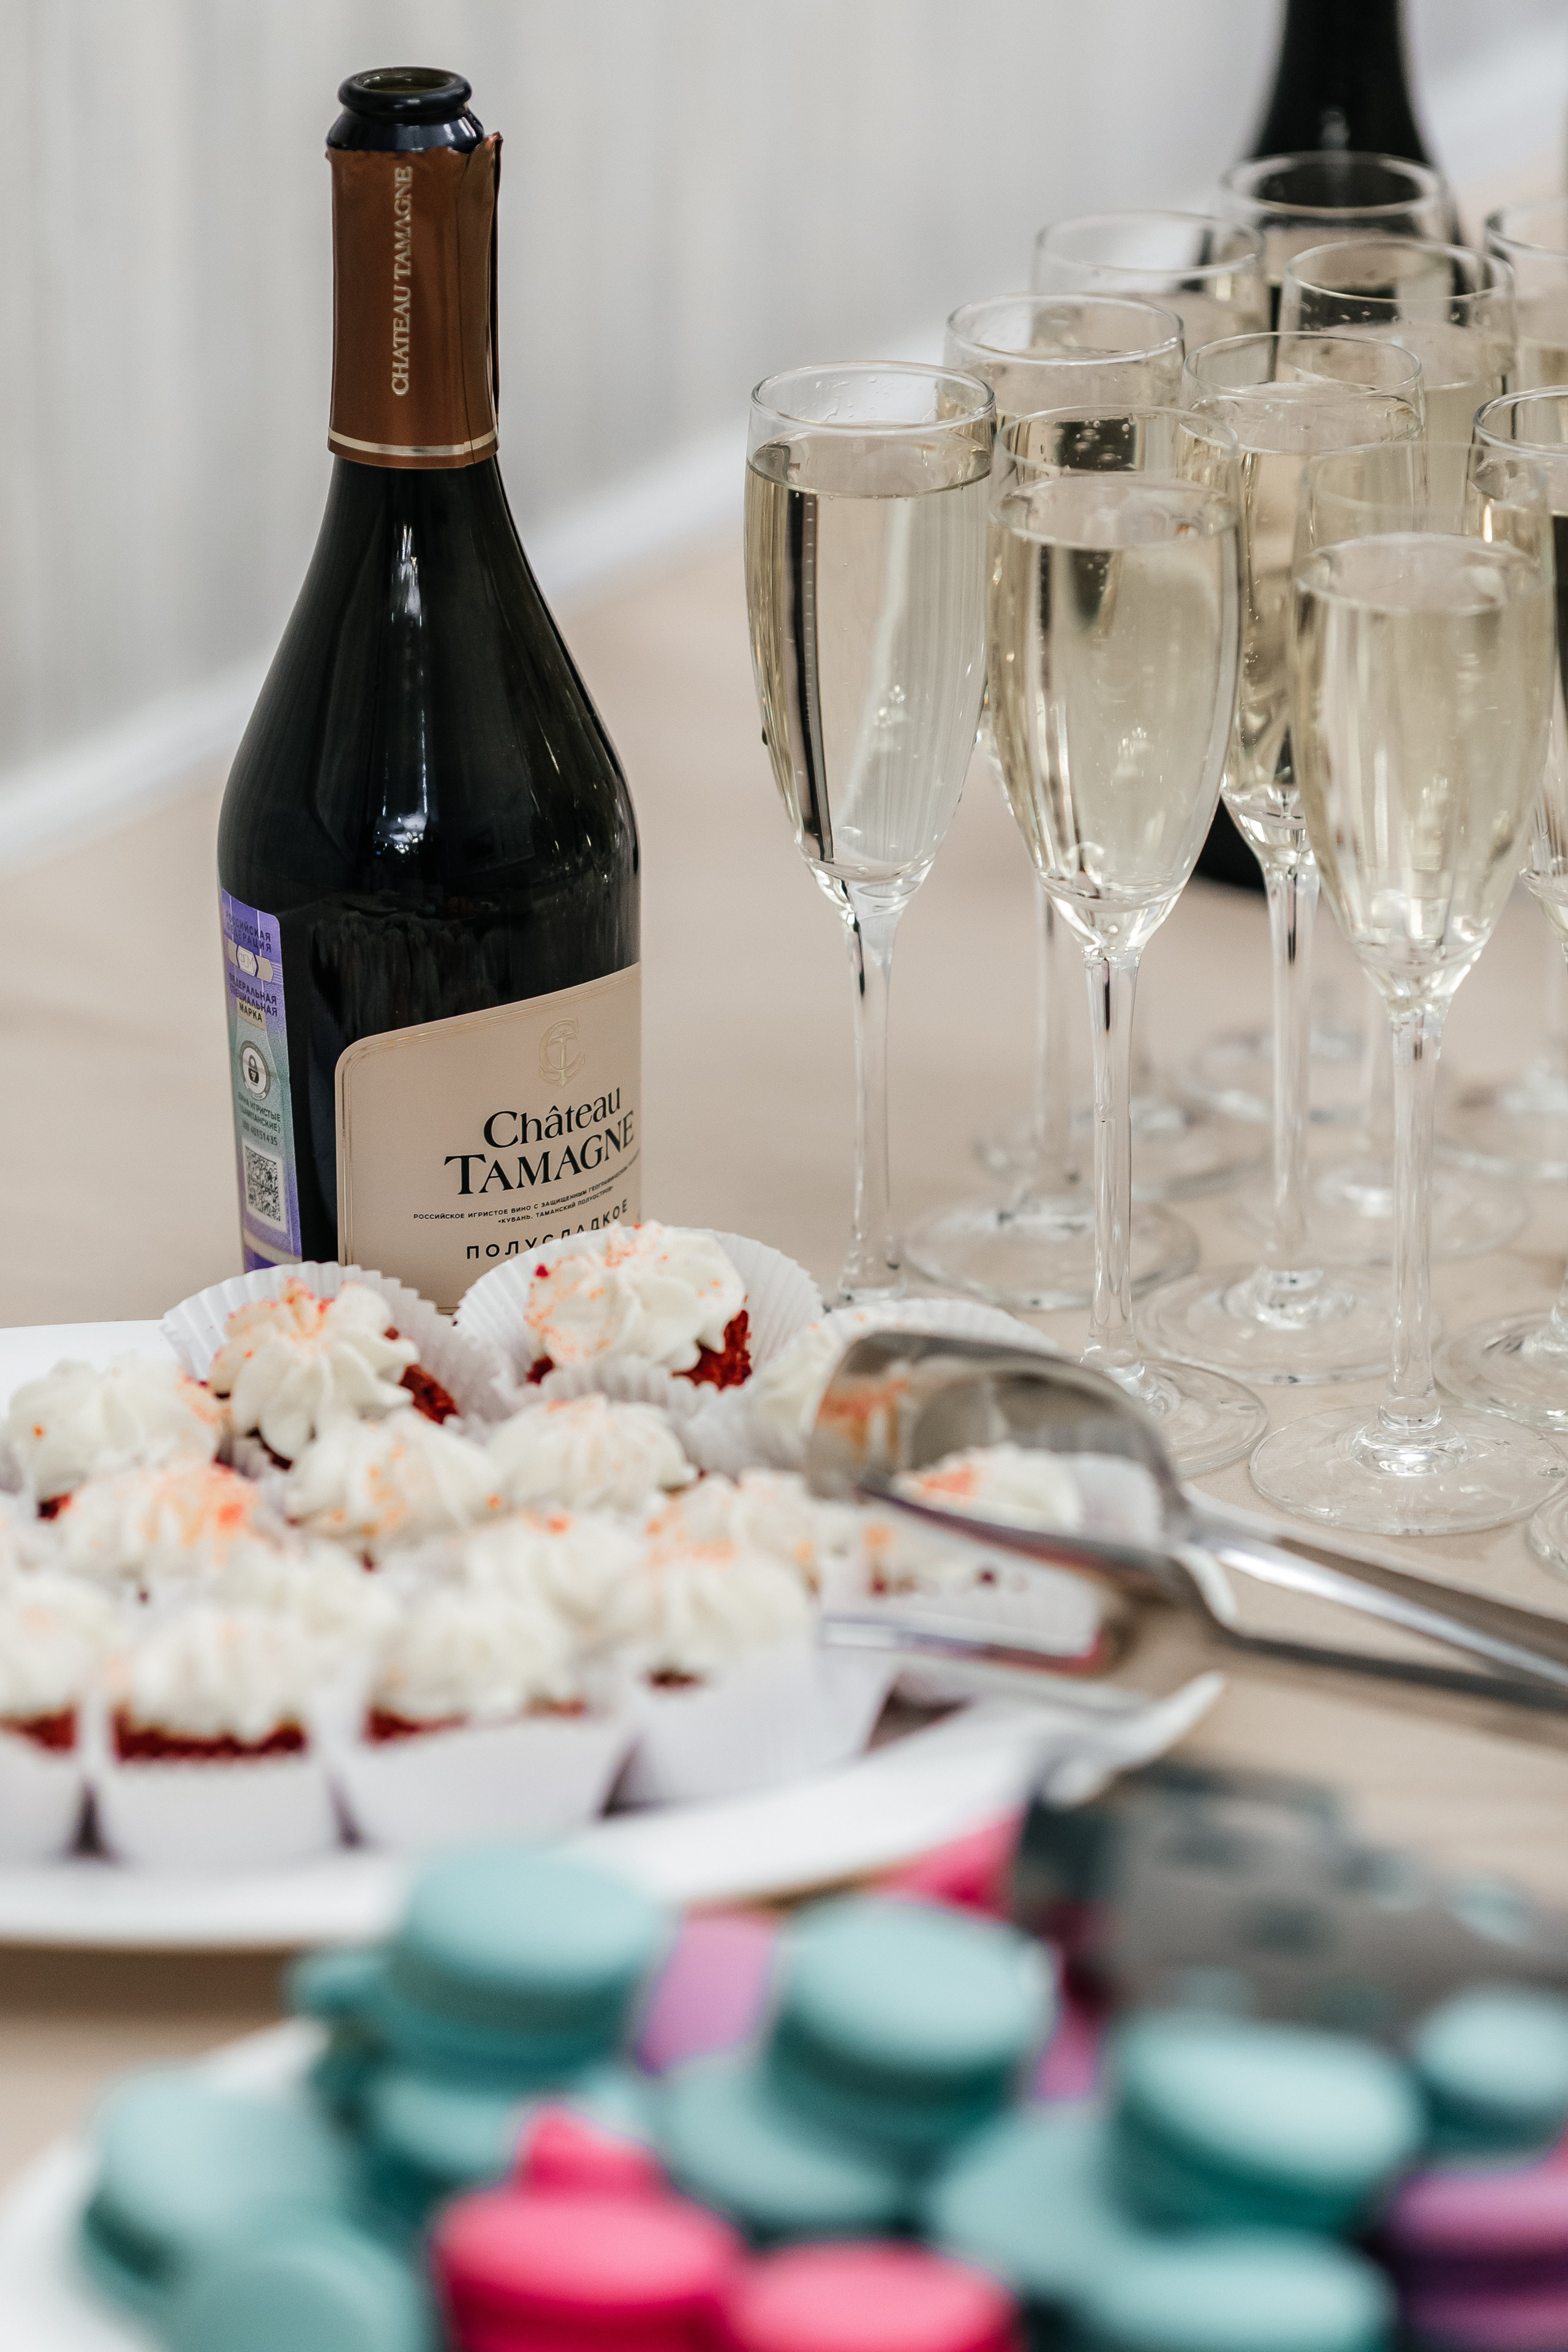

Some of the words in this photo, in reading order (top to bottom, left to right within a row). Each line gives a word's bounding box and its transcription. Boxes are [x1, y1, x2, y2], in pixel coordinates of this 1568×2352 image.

[394, 166, 413, 281] TAMAGNE
[391, 284, 412, 396] CHATEAU
[239, 1002, 263, 1023] МАРКА
[250, 1101, 281, 1122] ИГРИСТЫЕ
[483, 1087, 620, 1148] Château
[443, 1110, 634, 1195] TAMAGNE
[468, 1208, 508, 1218] ИГРИСТОЕ
[511, 1205, 531, 1213] ВИНО
[541, 1189, 587, 1208] ЗАЩИЩЕННЫМ
[536, 1202, 576, 1218] ТАМАНСКИЙ
